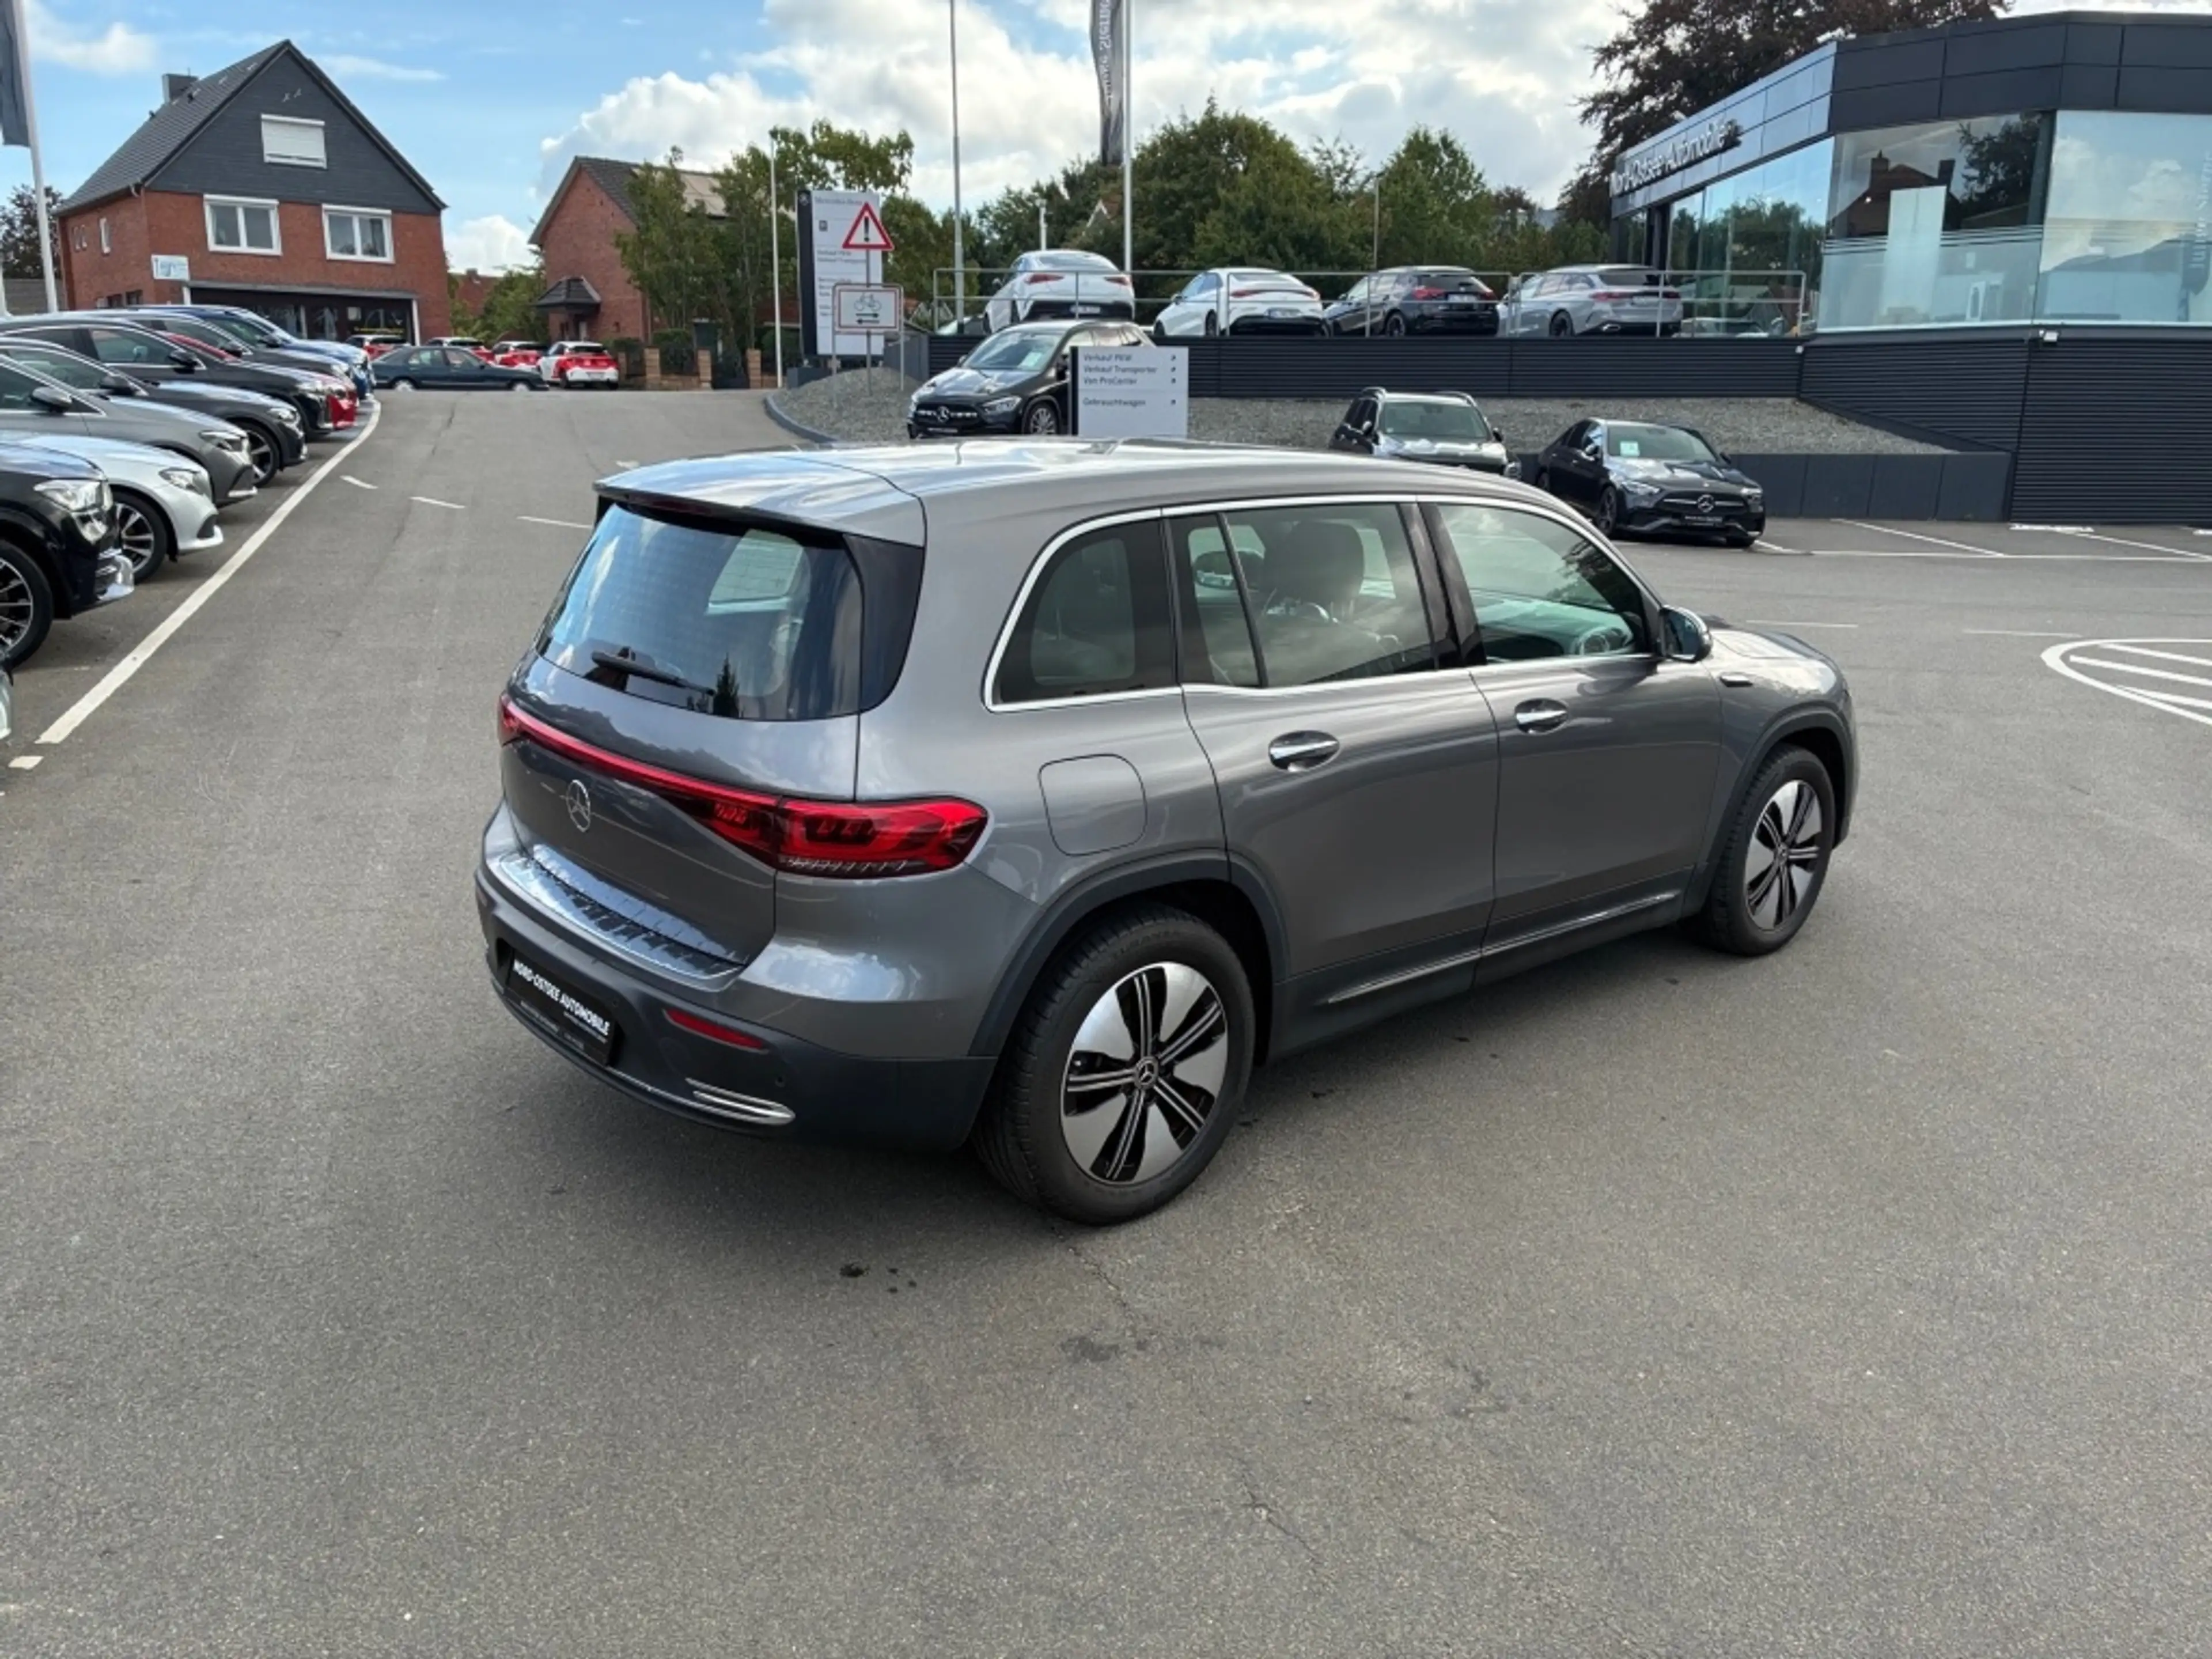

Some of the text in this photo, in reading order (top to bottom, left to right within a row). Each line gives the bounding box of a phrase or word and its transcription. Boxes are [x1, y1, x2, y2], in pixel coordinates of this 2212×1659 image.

[1084, 354, 1113, 362] Verkauf
[1084, 365, 1158, 374] Verkauf Transporter
[1082, 397, 1146, 408] Gebrauchtwagen
[559, 993, 611, 1036] AUTOMOBILE
